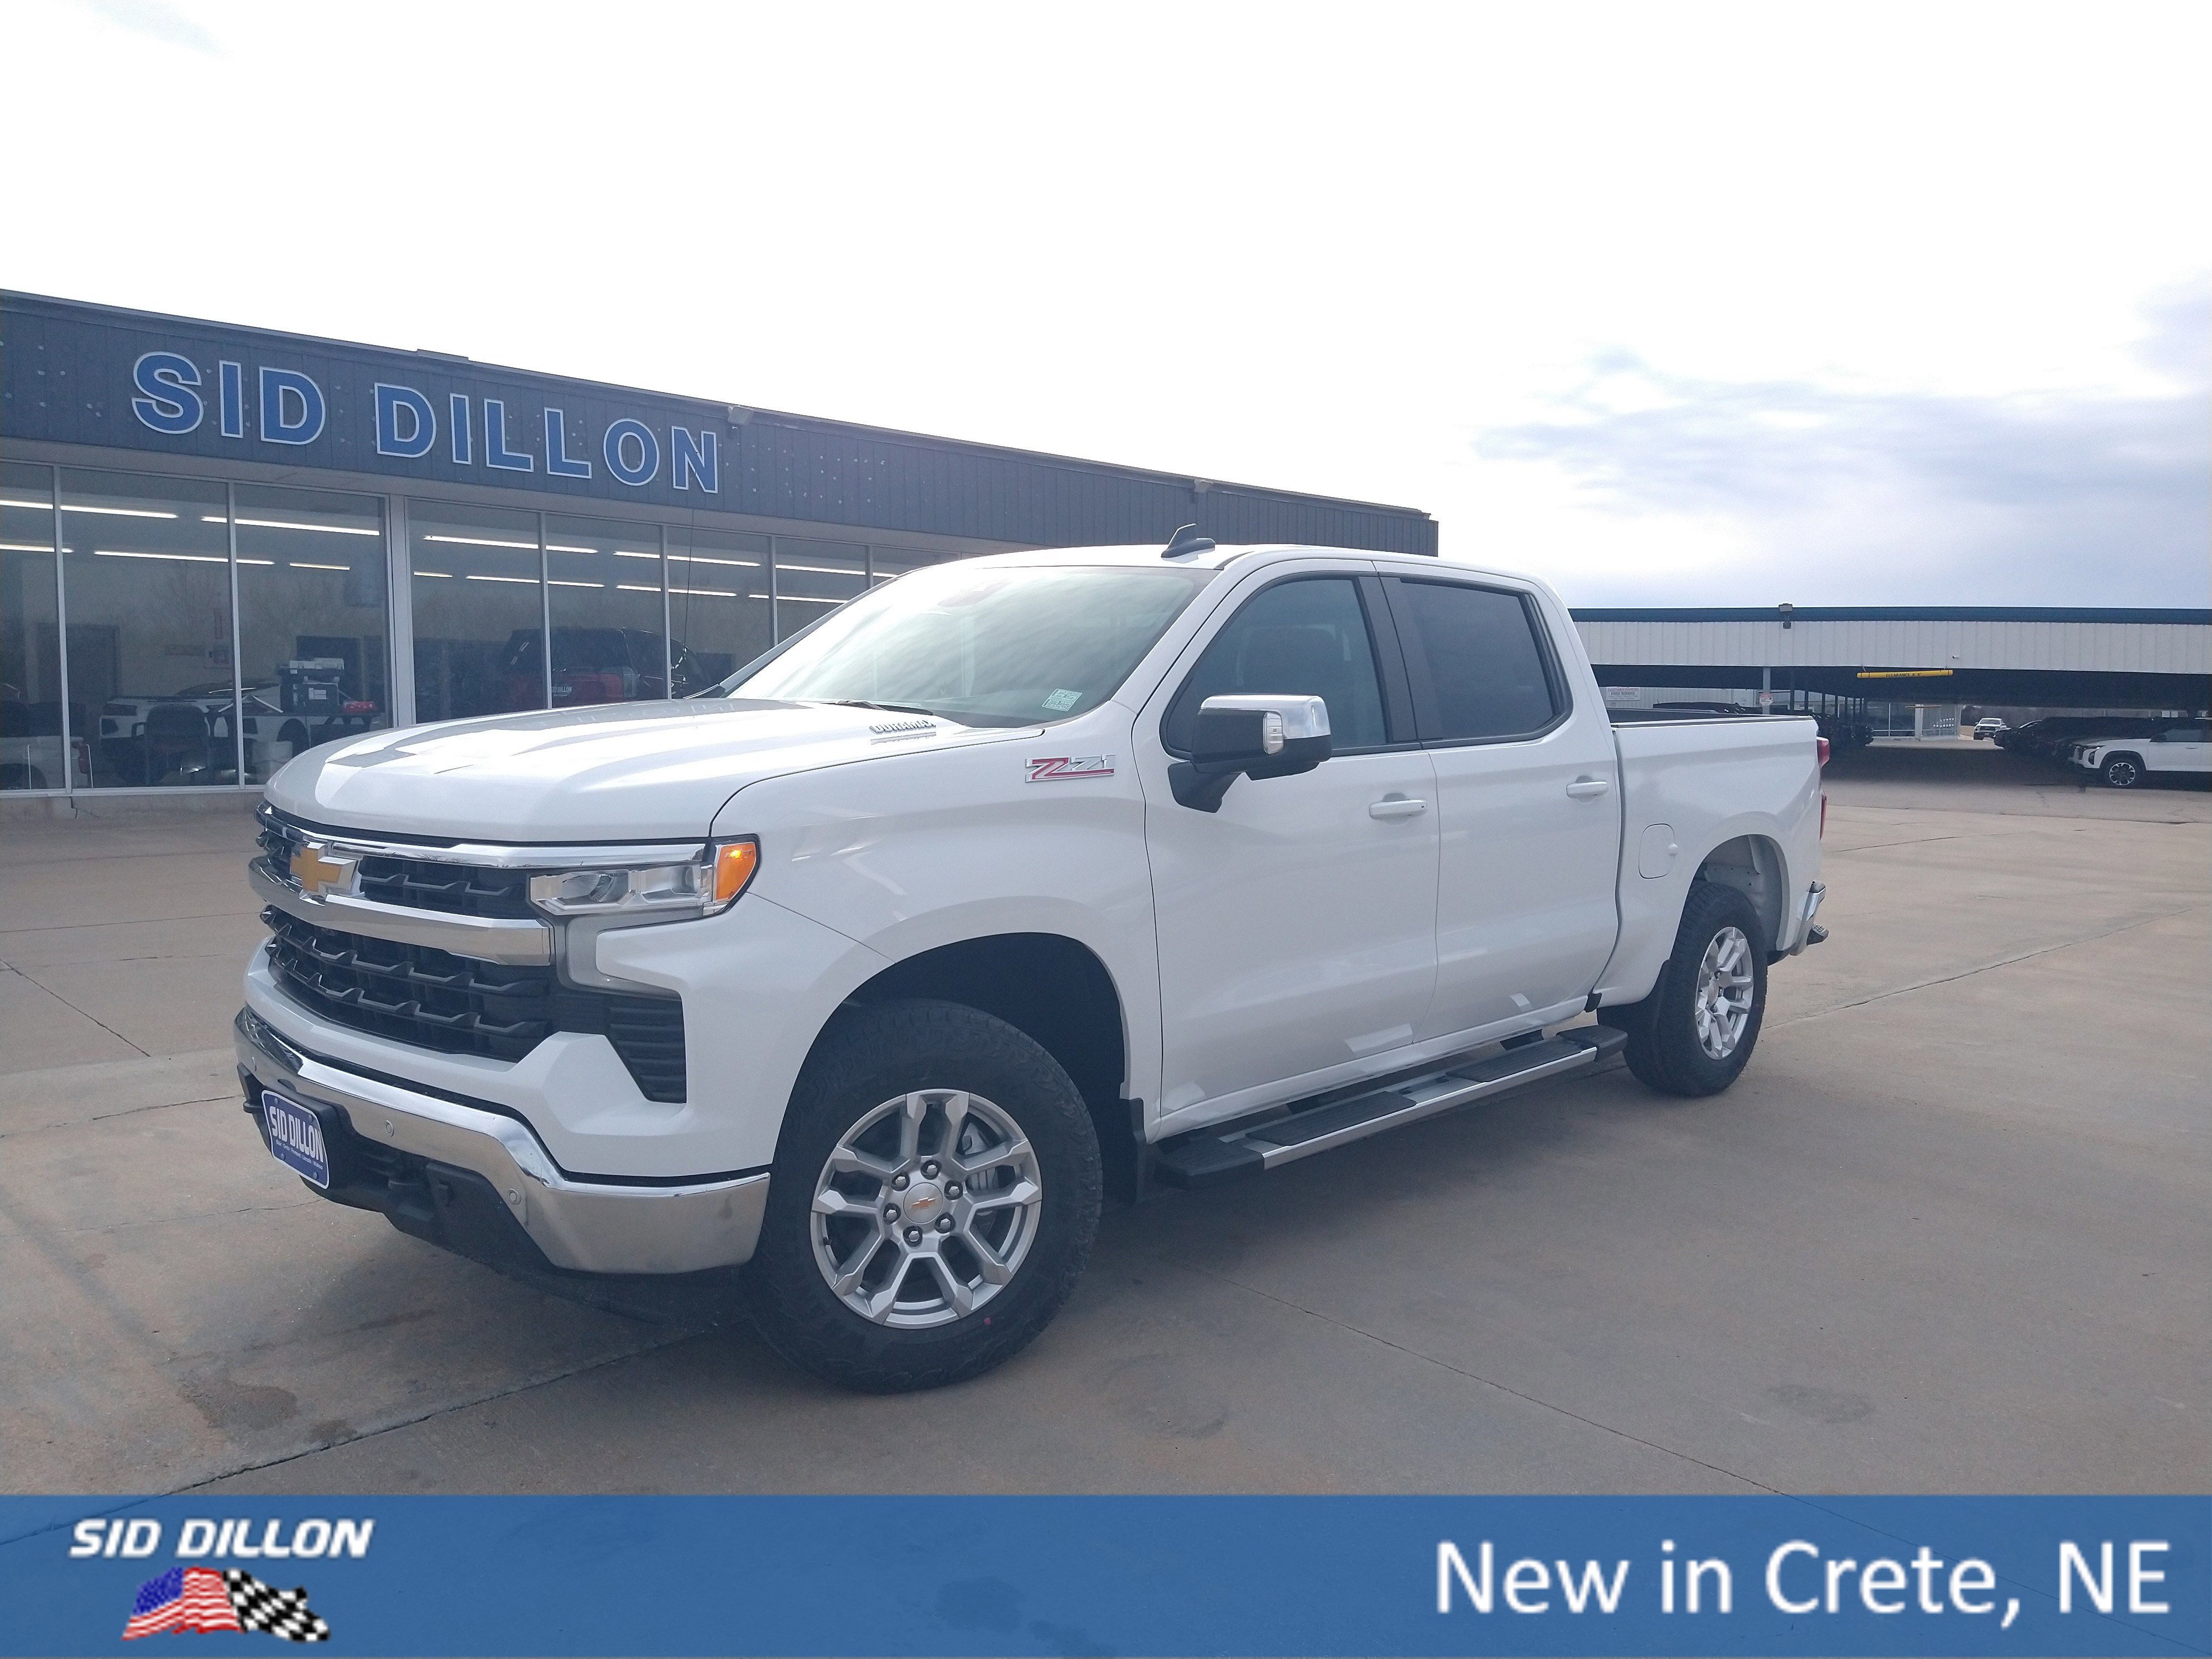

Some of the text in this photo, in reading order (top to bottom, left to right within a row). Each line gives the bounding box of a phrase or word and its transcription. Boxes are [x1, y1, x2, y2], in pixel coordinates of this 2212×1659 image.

[132, 351, 718, 493] SID DILLON
[1025, 754, 1115, 783] Z71
[269, 1105, 324, 1163] SID DILLON
